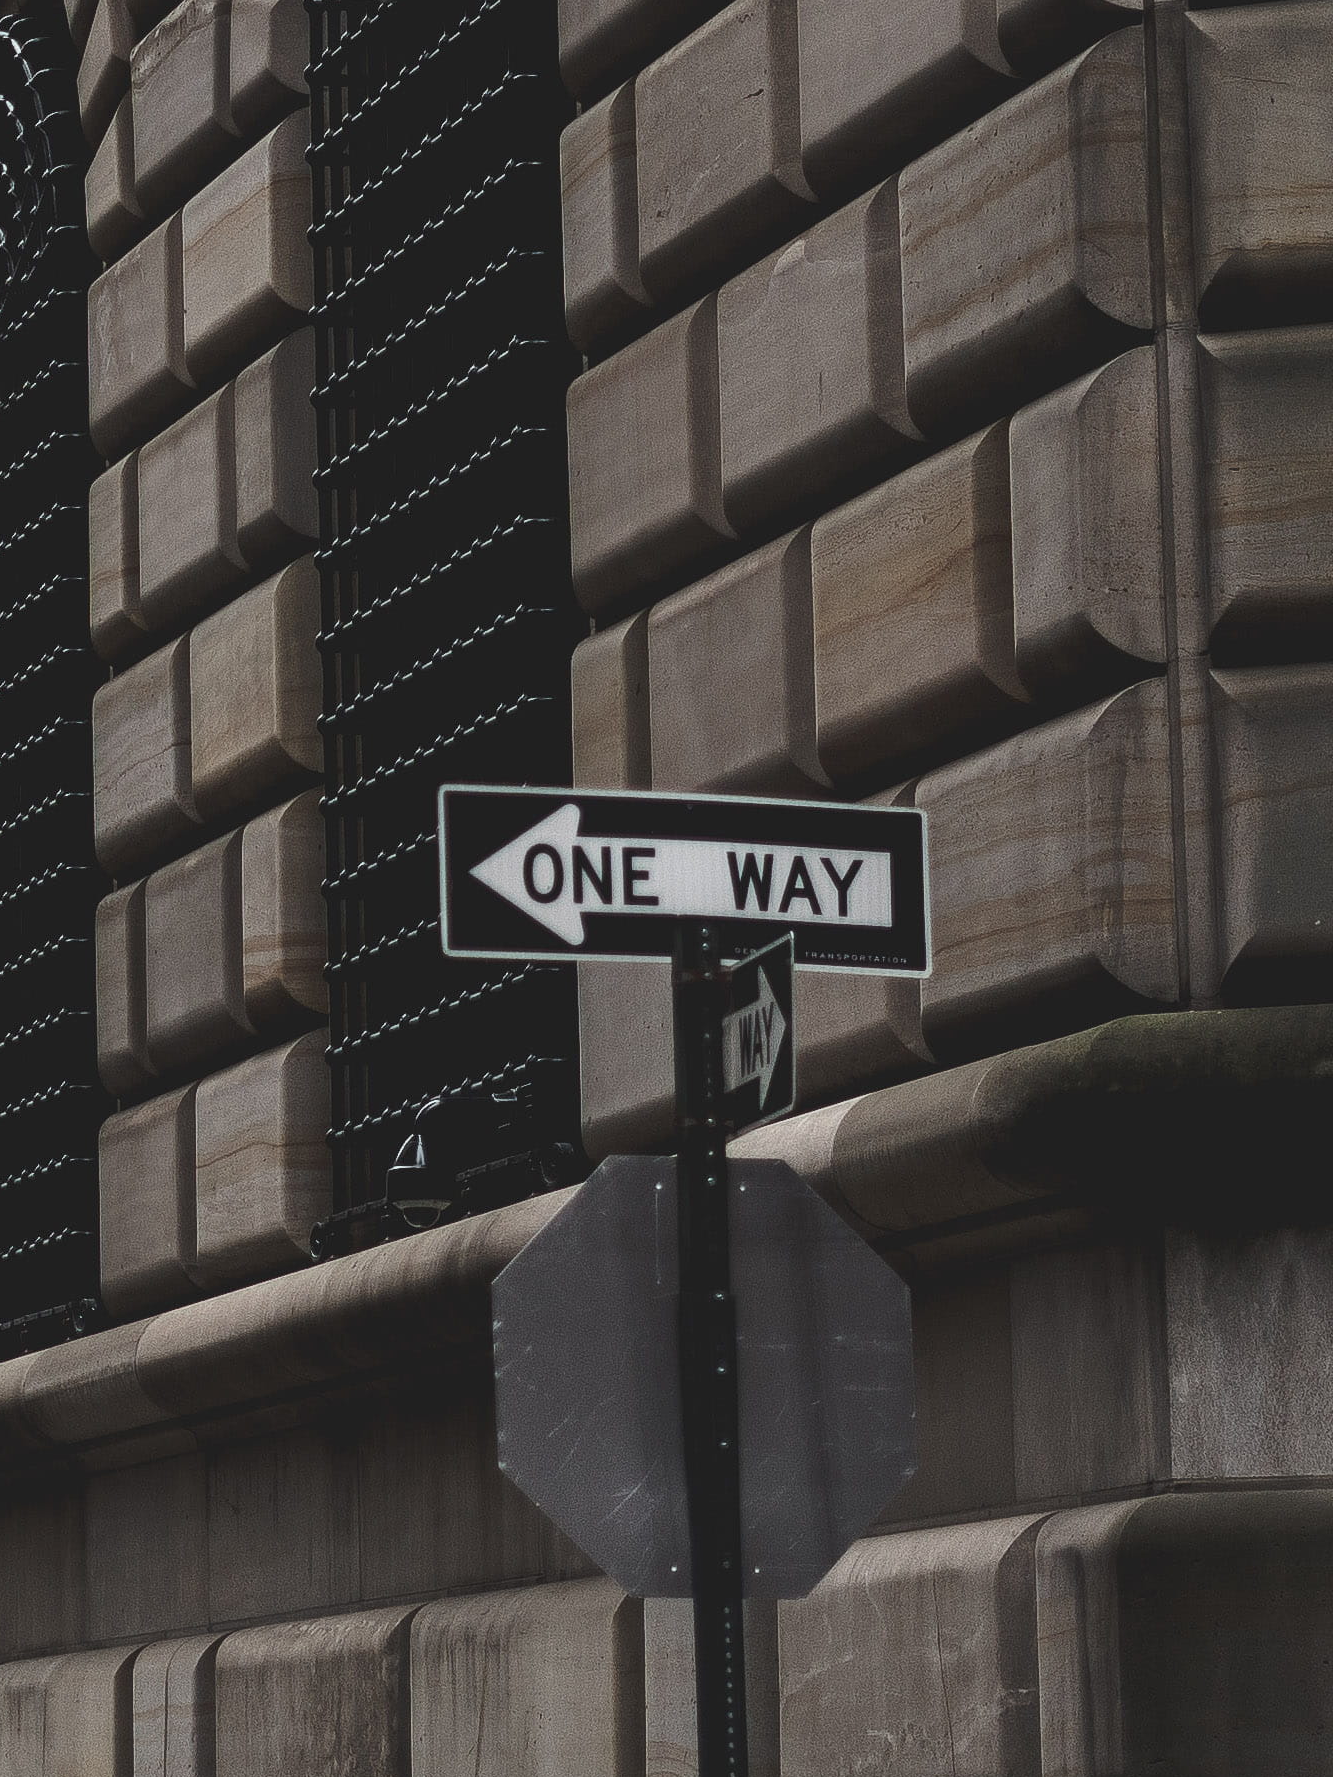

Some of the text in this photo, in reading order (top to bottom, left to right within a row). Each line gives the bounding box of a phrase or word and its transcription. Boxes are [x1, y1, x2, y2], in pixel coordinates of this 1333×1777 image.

[523, 843, 863, 918] ONE WAY
[805, 950, 907, 965] TRANSPORTATION
[739, 1002, 774, 1079] WAY
